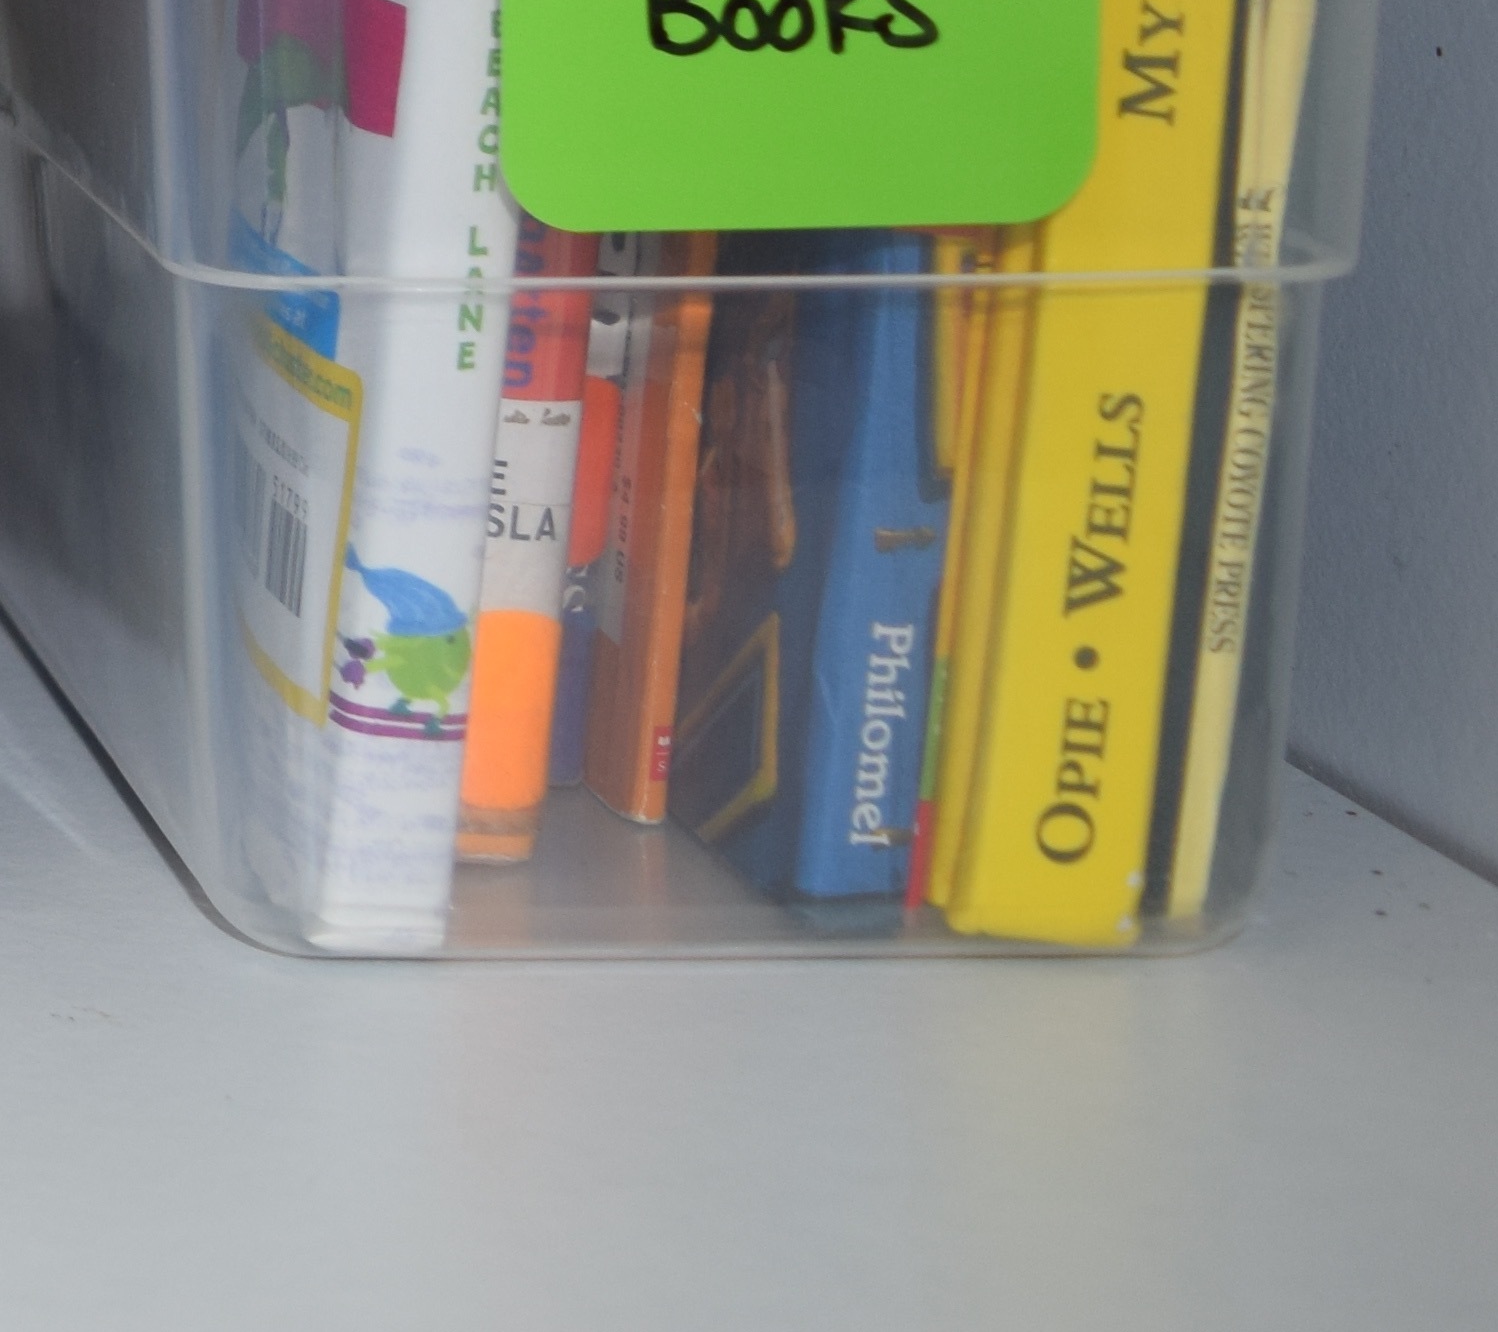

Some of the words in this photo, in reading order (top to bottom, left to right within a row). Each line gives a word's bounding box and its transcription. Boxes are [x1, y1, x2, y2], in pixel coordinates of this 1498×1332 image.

[1060, 390, 1147, 620] WELLS
[849, 621, 916, 848] Philomel
[1032, 696, 1112, 866] OPIE
